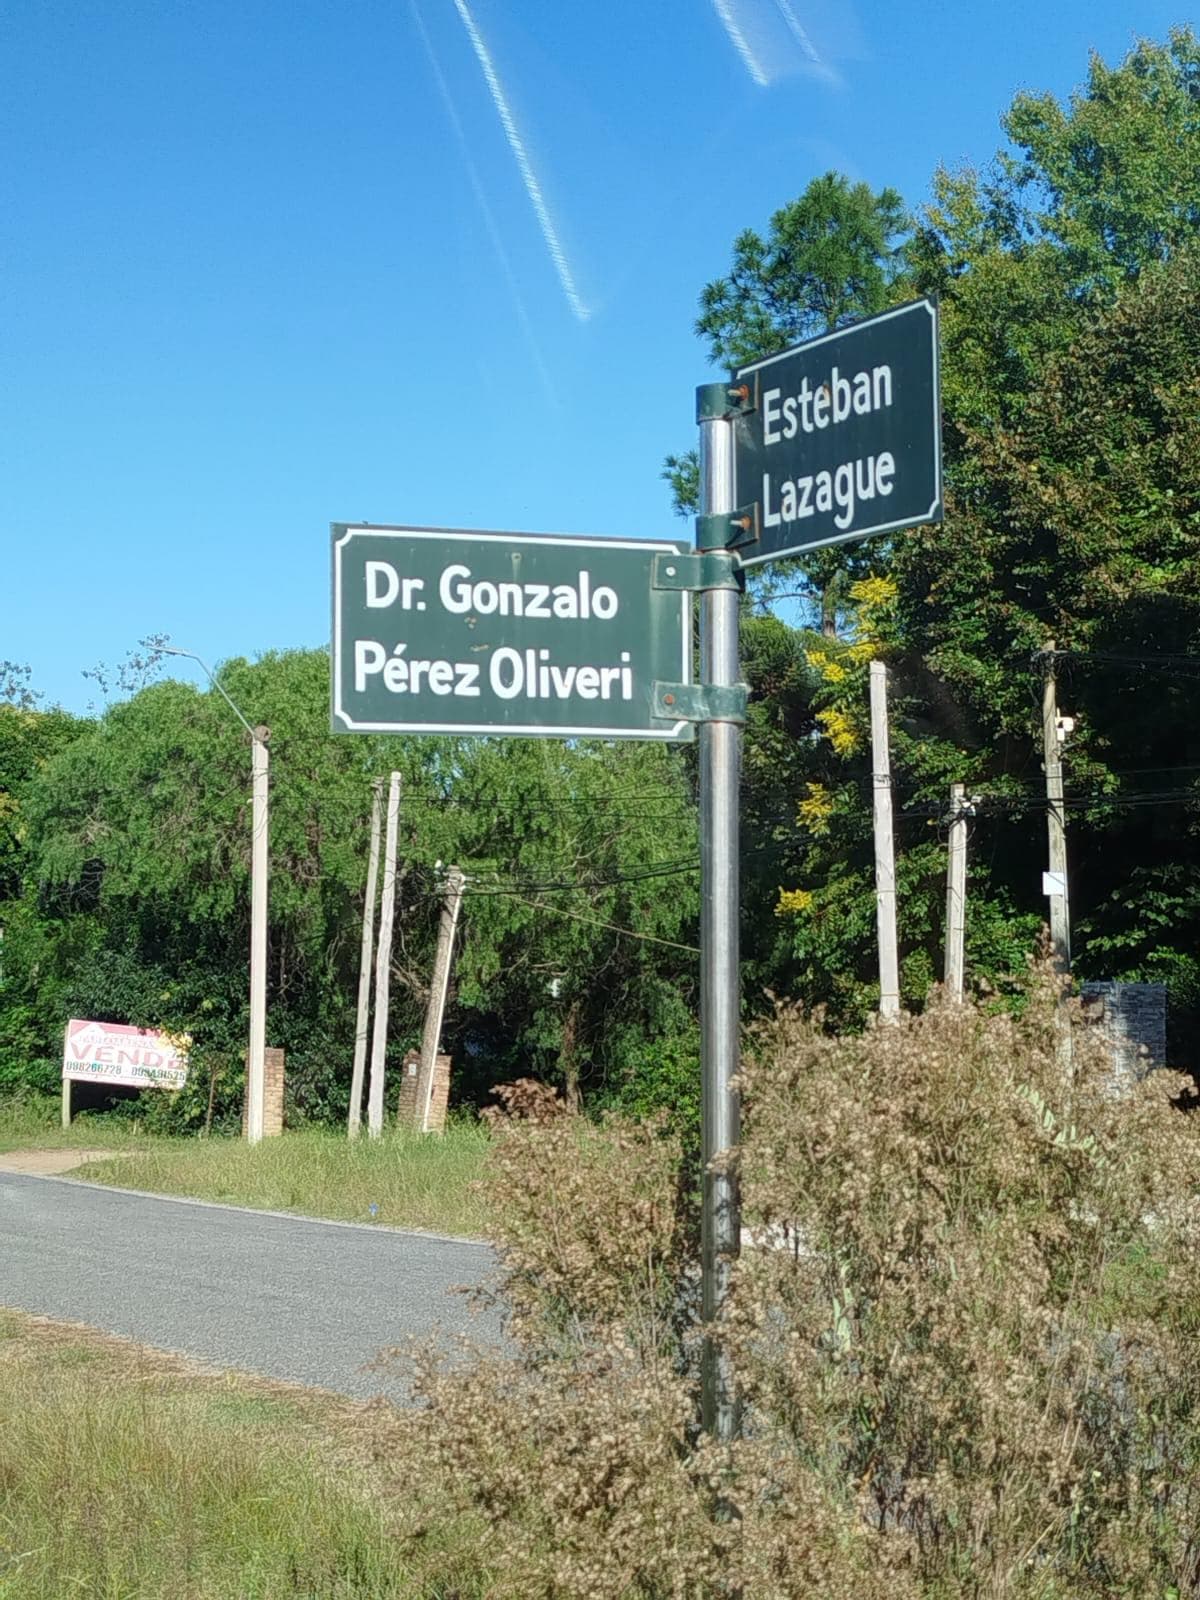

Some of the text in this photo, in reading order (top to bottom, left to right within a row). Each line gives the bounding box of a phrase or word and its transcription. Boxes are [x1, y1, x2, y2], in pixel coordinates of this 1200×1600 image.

[763, 364, 893, 446] Esteban
[763, 451, 895, 529] Lazague
[365, 561, 618, 619] Dr. Gonzalo
[354, 640, 632, 700] Pérez Oliveri
